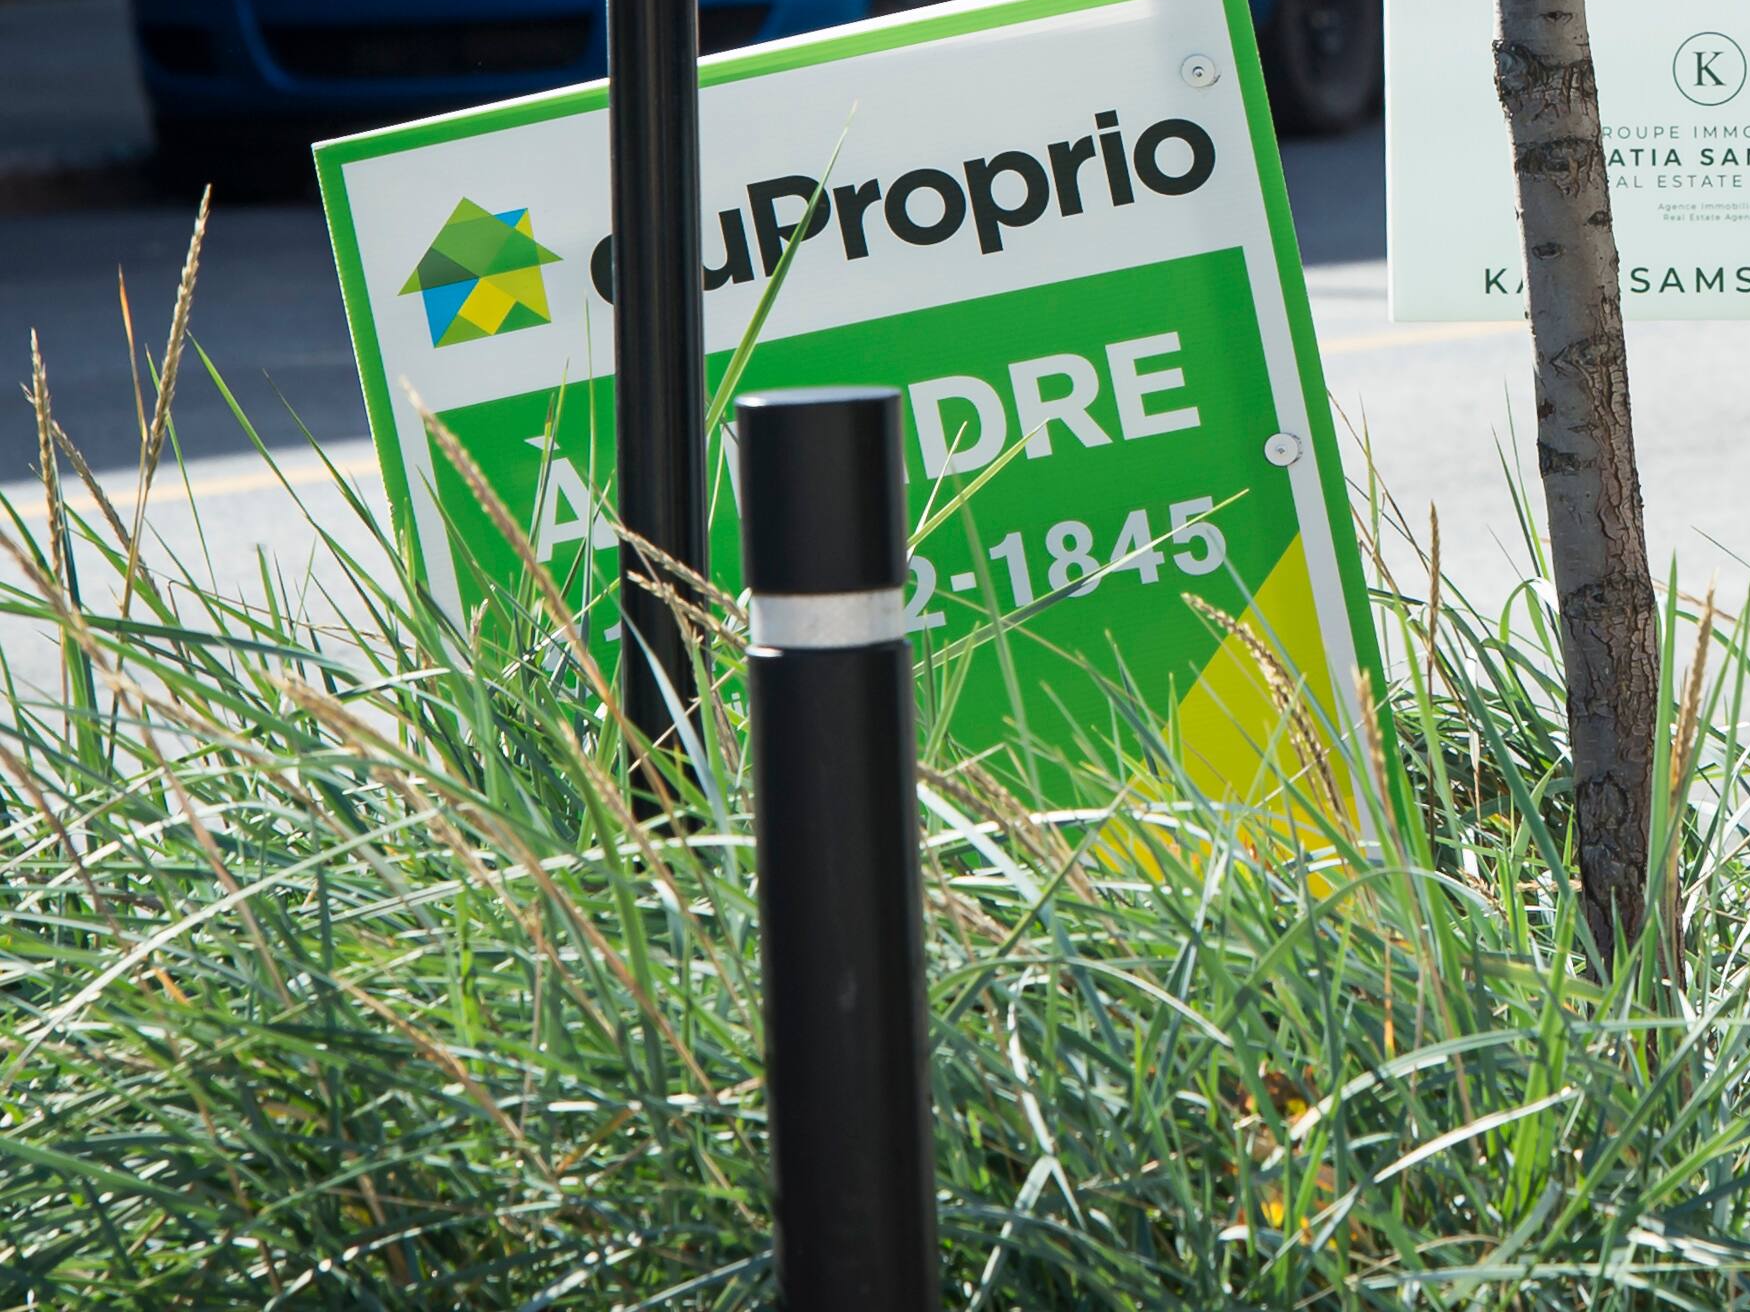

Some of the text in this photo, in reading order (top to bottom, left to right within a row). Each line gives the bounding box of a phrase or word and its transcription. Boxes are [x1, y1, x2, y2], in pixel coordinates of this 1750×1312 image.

[1692, 51, 1727, 86] K
[1601, 125, 1681, 139] ROUPE
[1607, 148, 1682, 167] ATIA
[1657, 175, 1743, 188] ESTATE
[590, 110, 1216, 306] uProprio
[903, 495, 1227, 634] 2-1845
